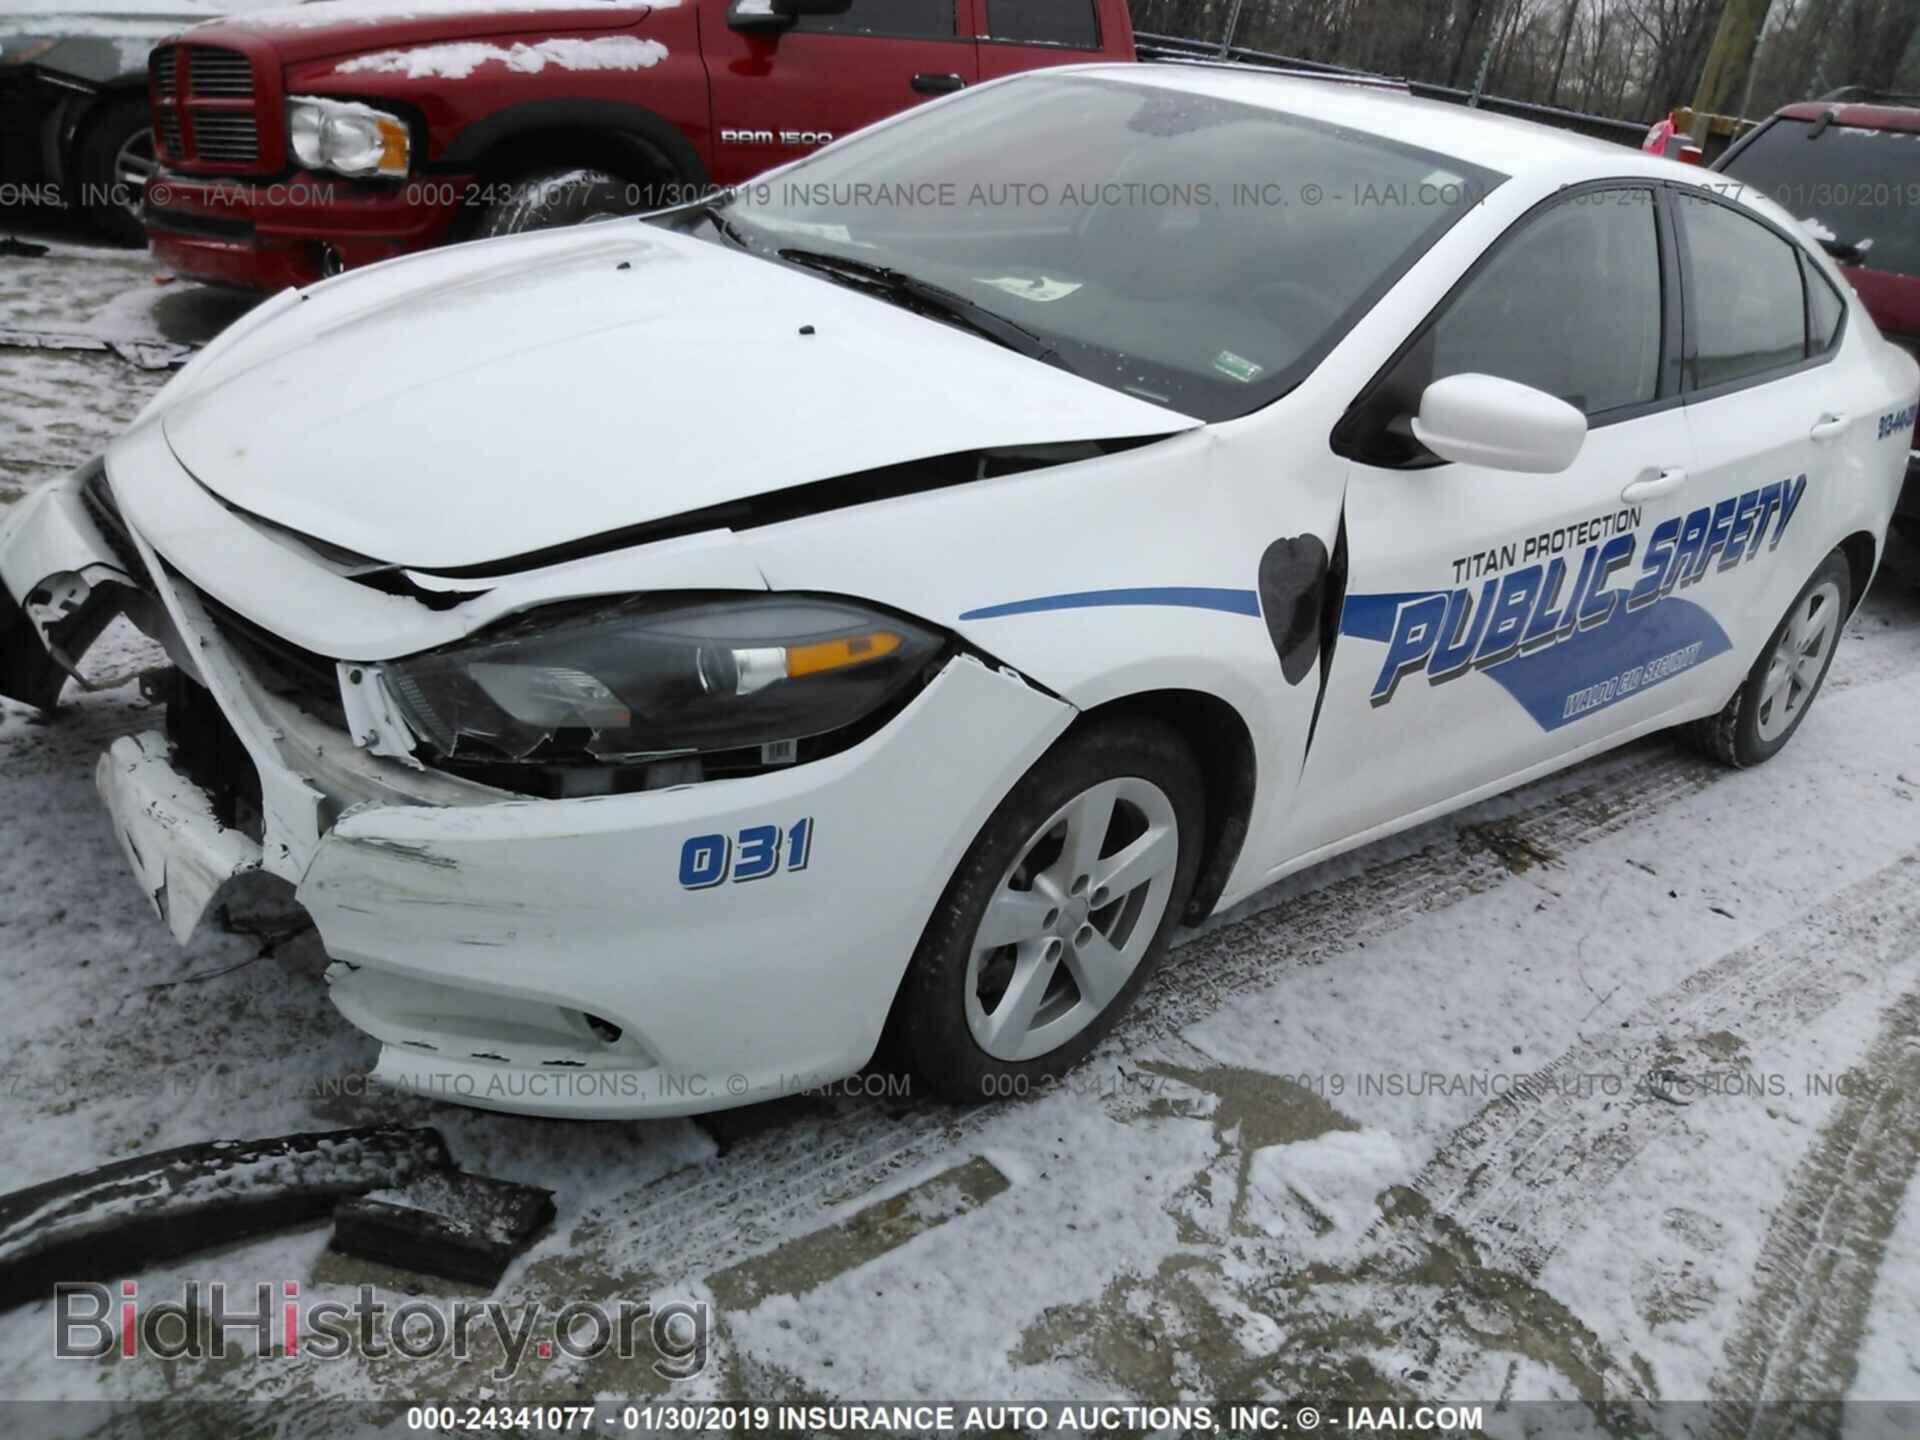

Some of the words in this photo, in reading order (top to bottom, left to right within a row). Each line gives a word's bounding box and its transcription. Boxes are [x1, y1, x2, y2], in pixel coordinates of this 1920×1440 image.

[721, 129, 773, 144] RAM
[779, 131, 833, 144] 1500
[1452, 545, 1516, 584] TITAN
[1523, 507, 1643, 563] PROTECTION
[1369, 533, 1637, 709] PUBLIC
[1626, 473, 1808, 614] SAFETY
[678, 815, 815, 891] 031
